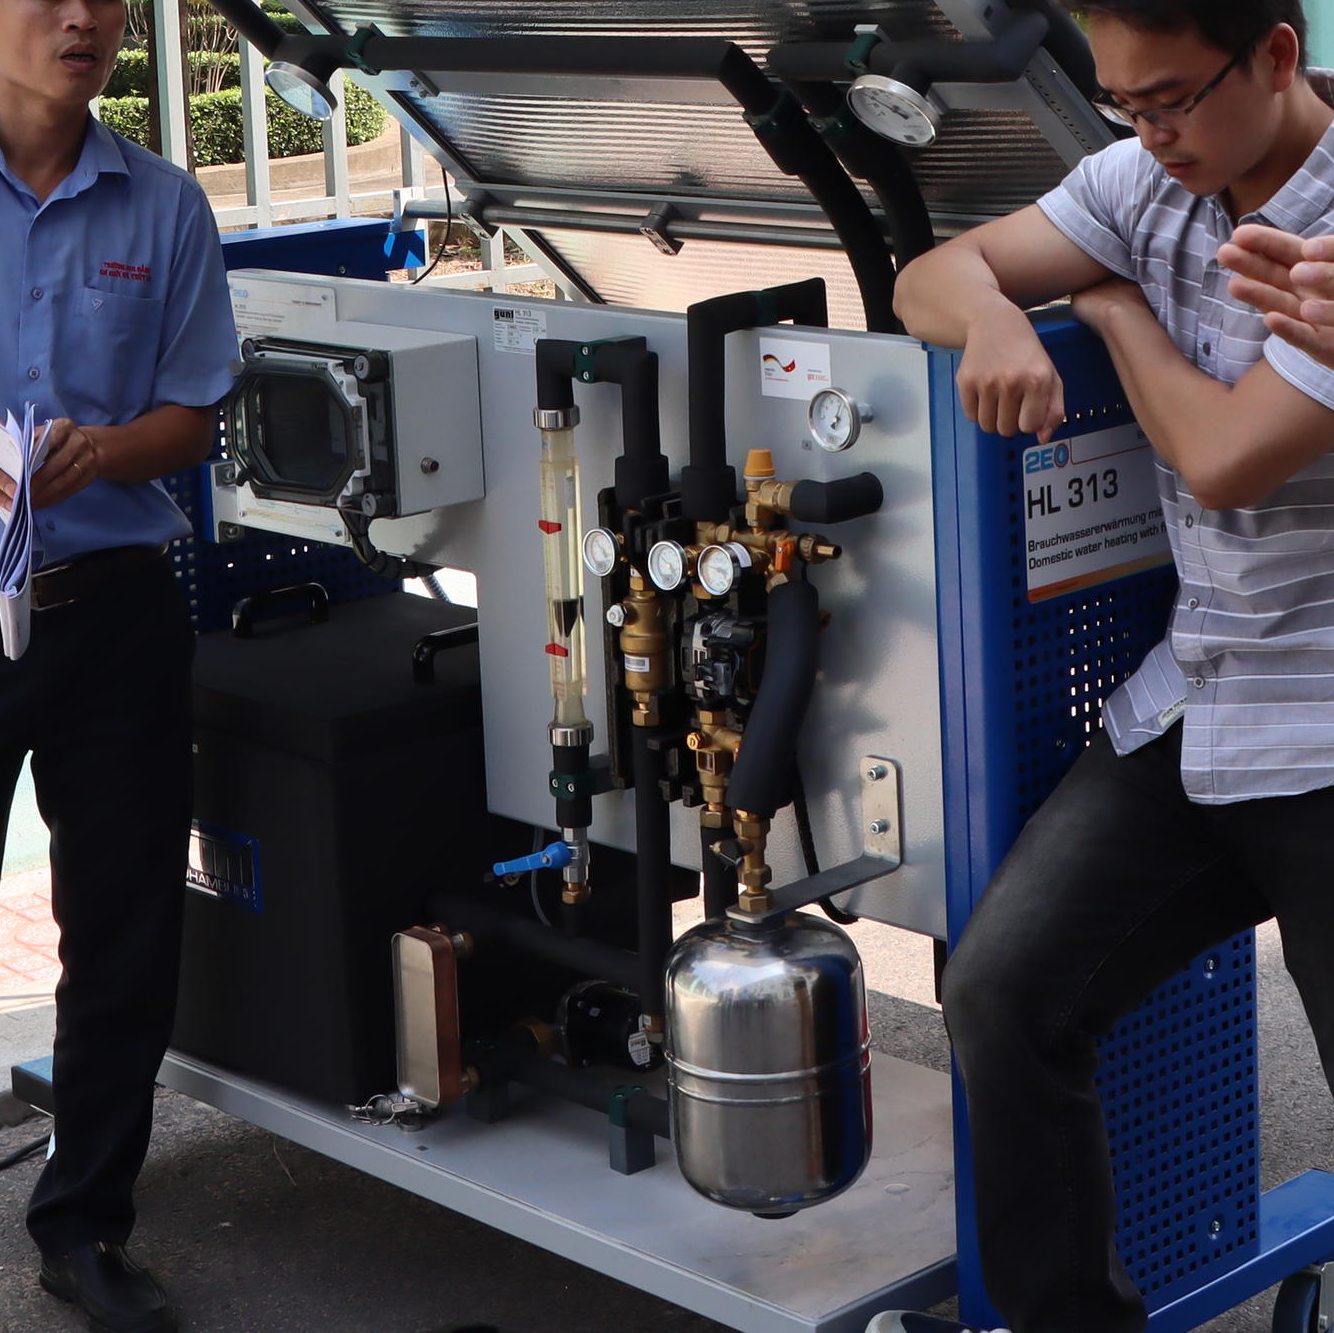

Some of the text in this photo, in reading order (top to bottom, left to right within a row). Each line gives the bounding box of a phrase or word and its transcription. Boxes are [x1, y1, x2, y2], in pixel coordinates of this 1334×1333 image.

[1027, 468, 1119, 520] HL 313
[1028, 513, 1147, 552] Brauchwassererwärmung
[1029, 548, 1073, 570] Domestic
[1075, 541, 1102, 557] water
[1104, 530, 1138, 548] heating
[1139, 524, 1159, 538] with
